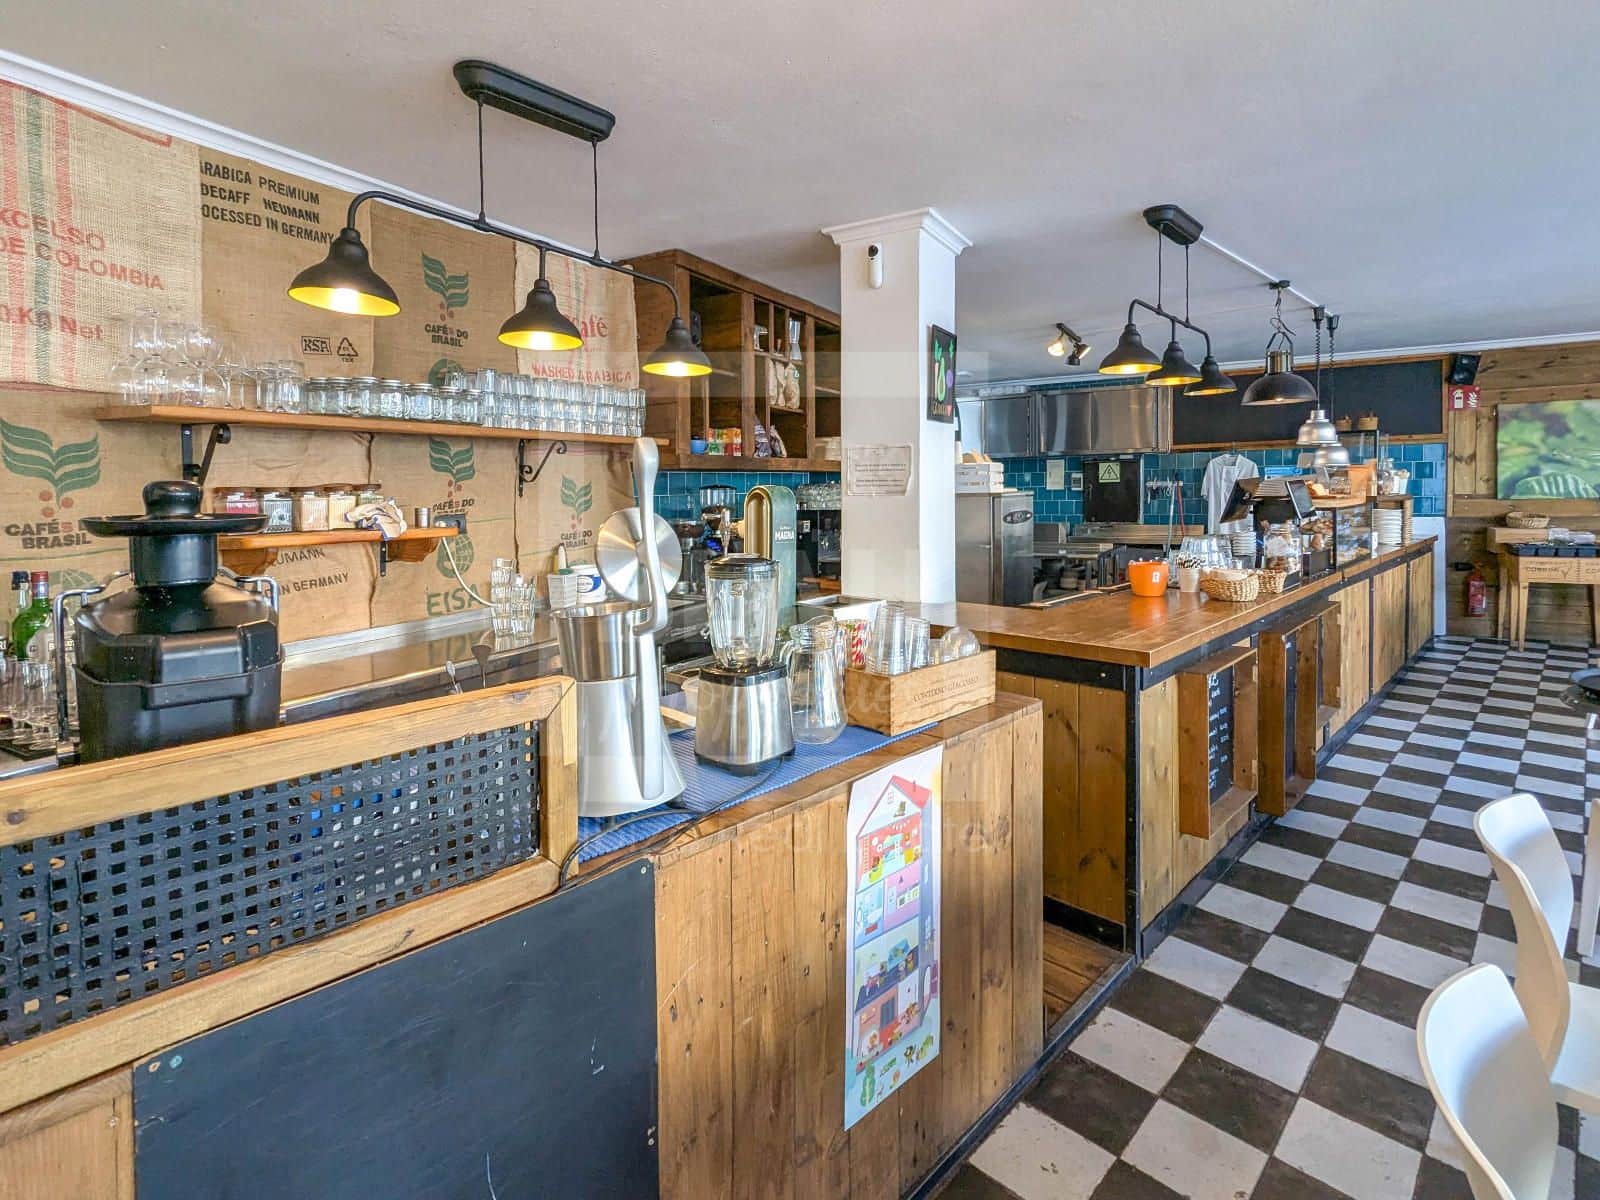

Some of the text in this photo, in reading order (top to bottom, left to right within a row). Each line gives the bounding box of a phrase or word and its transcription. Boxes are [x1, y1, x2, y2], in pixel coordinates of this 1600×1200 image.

[258, 175, 320, 205] PREMIUM
[200, 182, 320, 224] DECAFF NEUMANN
[266, 216, 279, 232] IN
[281, 222, 335, 245] GERMANY
[35, 242, 165, 291] COLOMBIA
[580, 313, 608, 338] afé
[531, 362, 575, 380] WASHED
[461, 498, 475, 508] DO
[5, 518, 74, 536] CAFÉS
[22, 532, 92, 549] BRASIL
[293, 572, 349, 592] GERMANY
[426, 583, 484, 616] EISA
